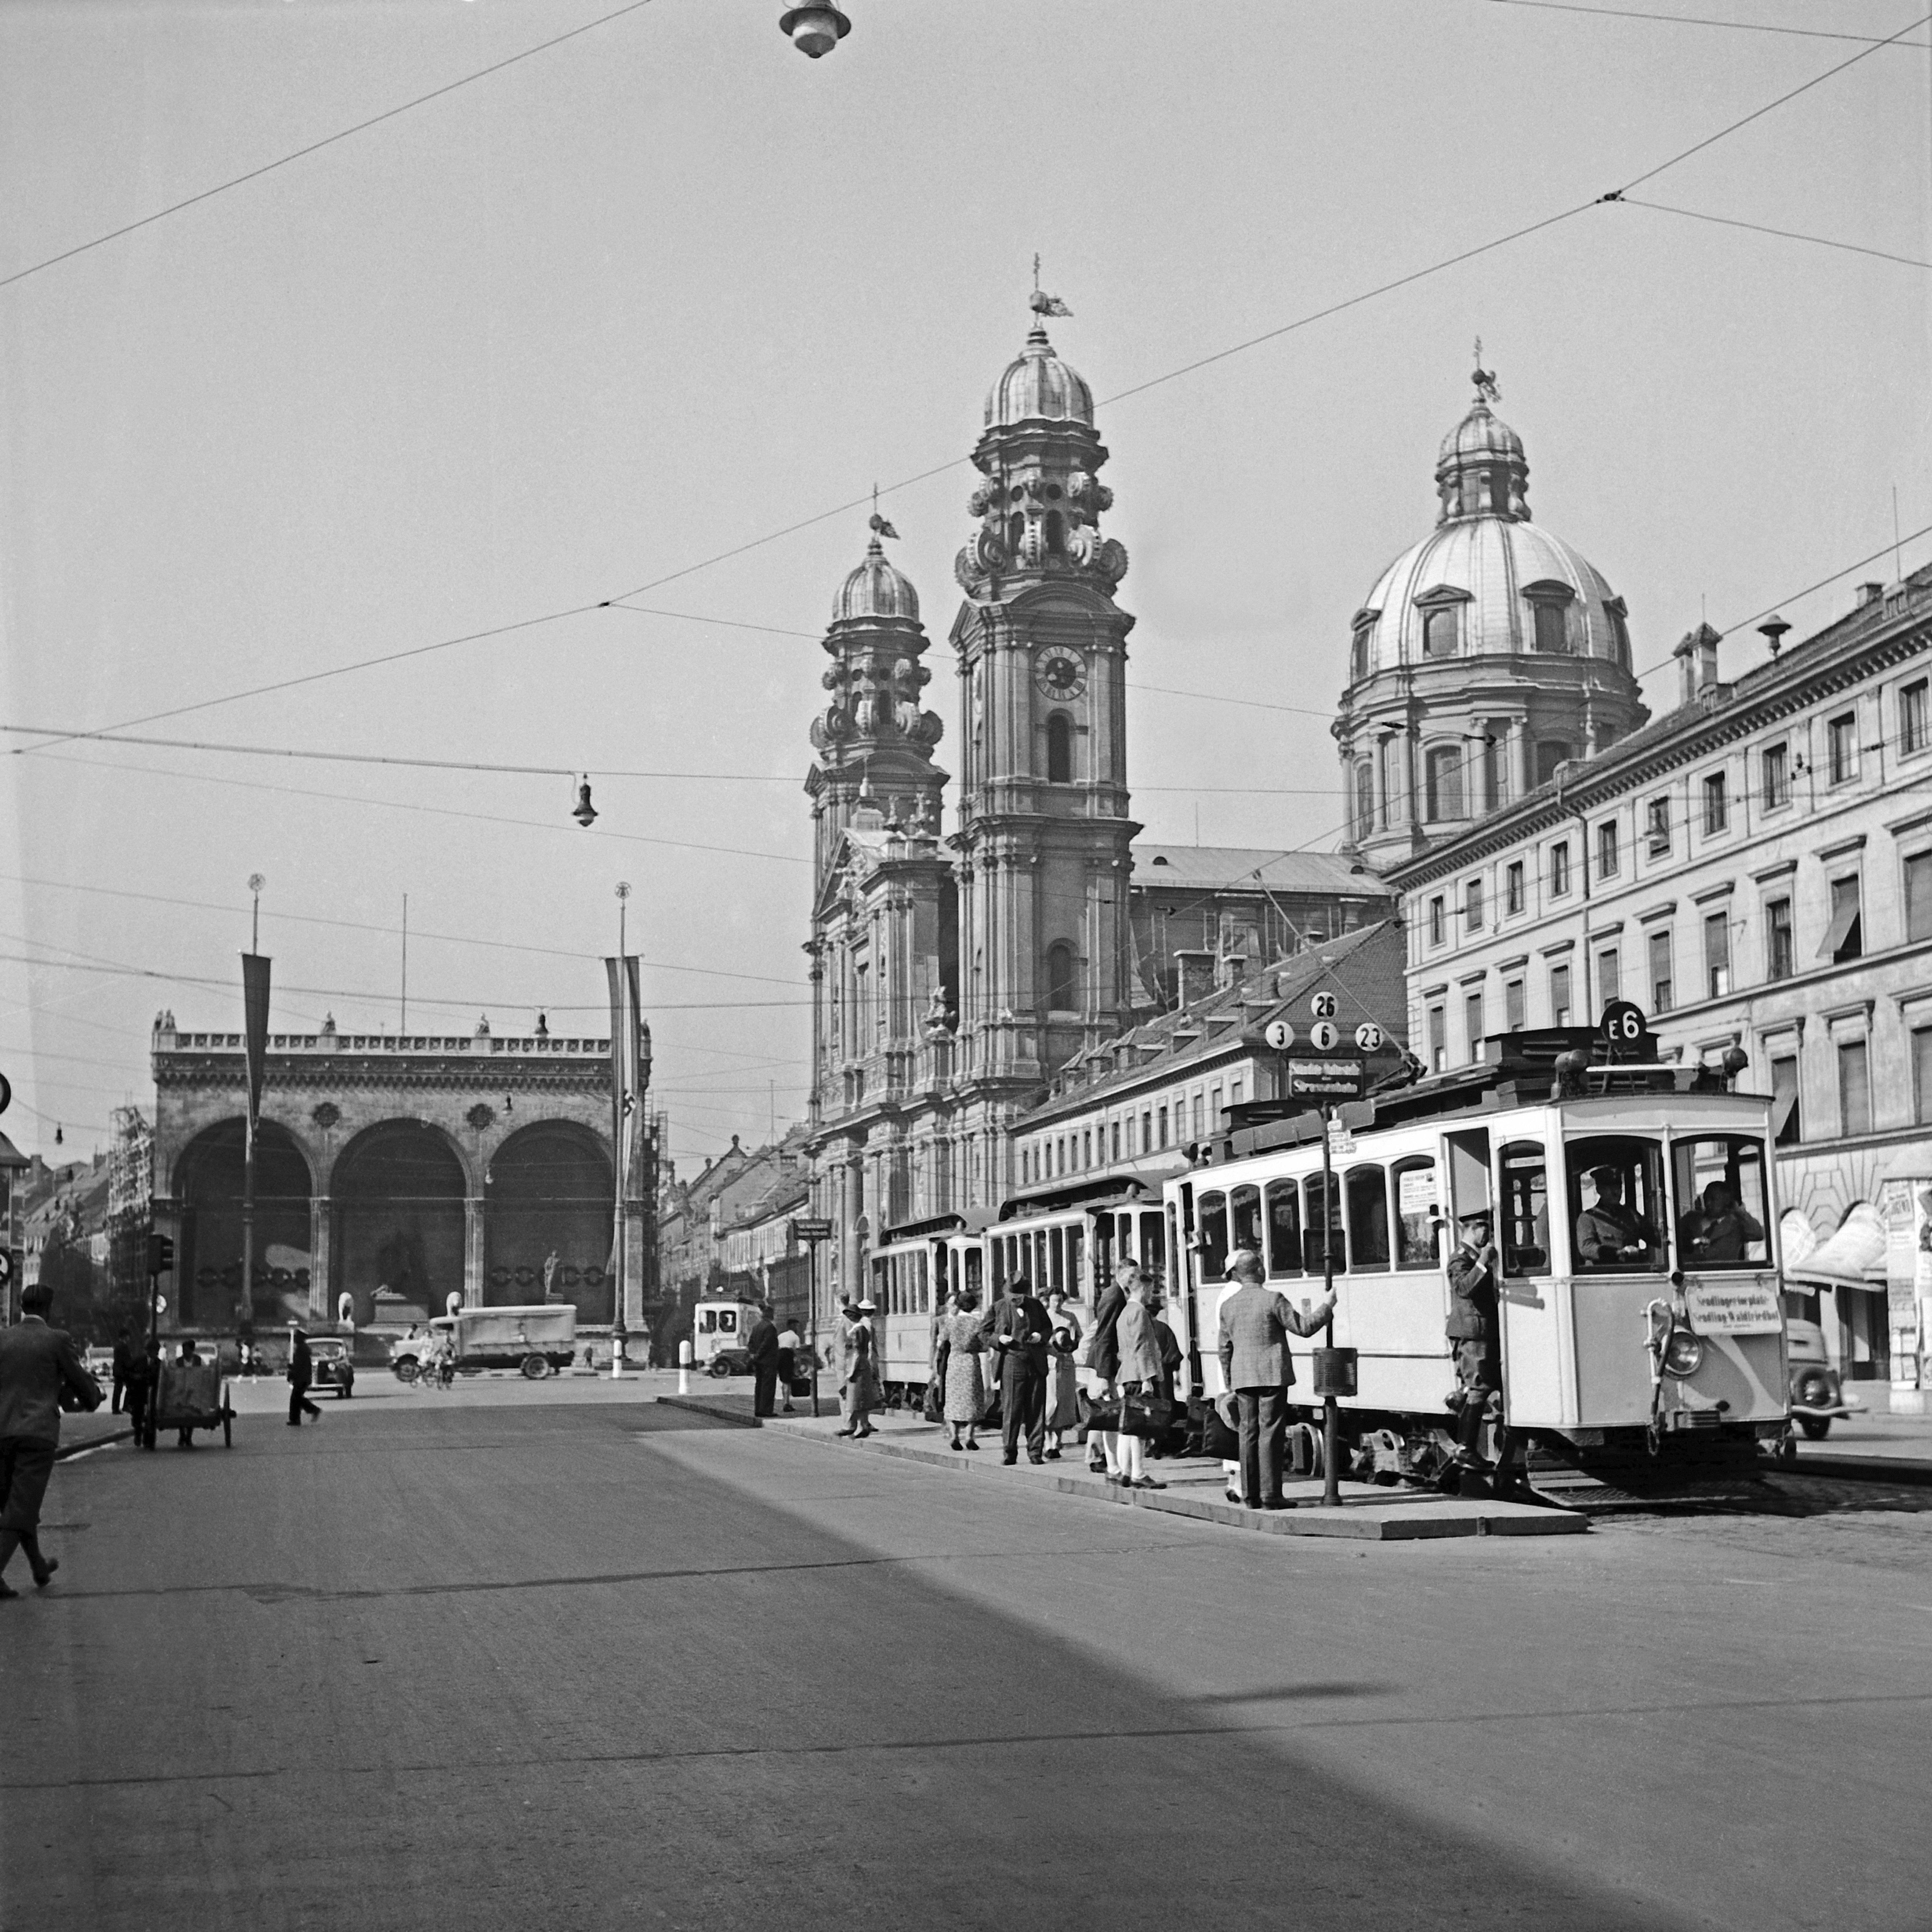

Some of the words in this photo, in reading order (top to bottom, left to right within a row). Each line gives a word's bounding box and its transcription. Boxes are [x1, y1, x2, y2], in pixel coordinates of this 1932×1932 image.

[1317, 996, 1335, 1017] 26
[1277, 1025, 1285, 1045] 3
[1321, 1025, 1330, 1046] 6
[1361, 1027, 1380, 1047] 23
